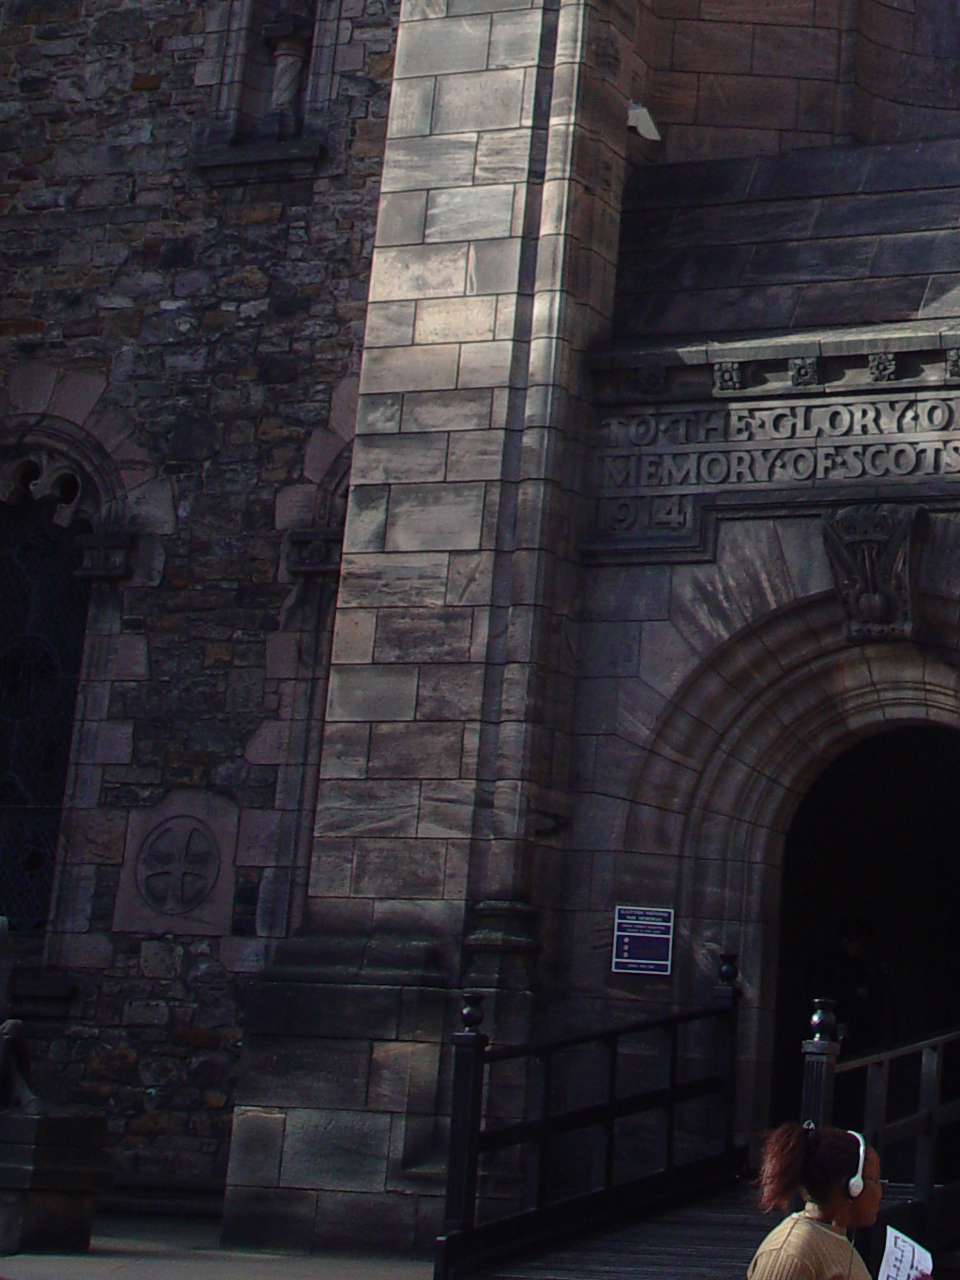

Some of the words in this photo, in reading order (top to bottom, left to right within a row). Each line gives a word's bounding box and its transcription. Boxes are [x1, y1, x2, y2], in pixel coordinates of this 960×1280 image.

[601, 414, 657, 447] TO
[668, 408, 751, 444] THE
[769, 401, 911, 439] GLORY
[602, 449, 781, 488] MEMORY
[790, 445, 836, 480] OF
